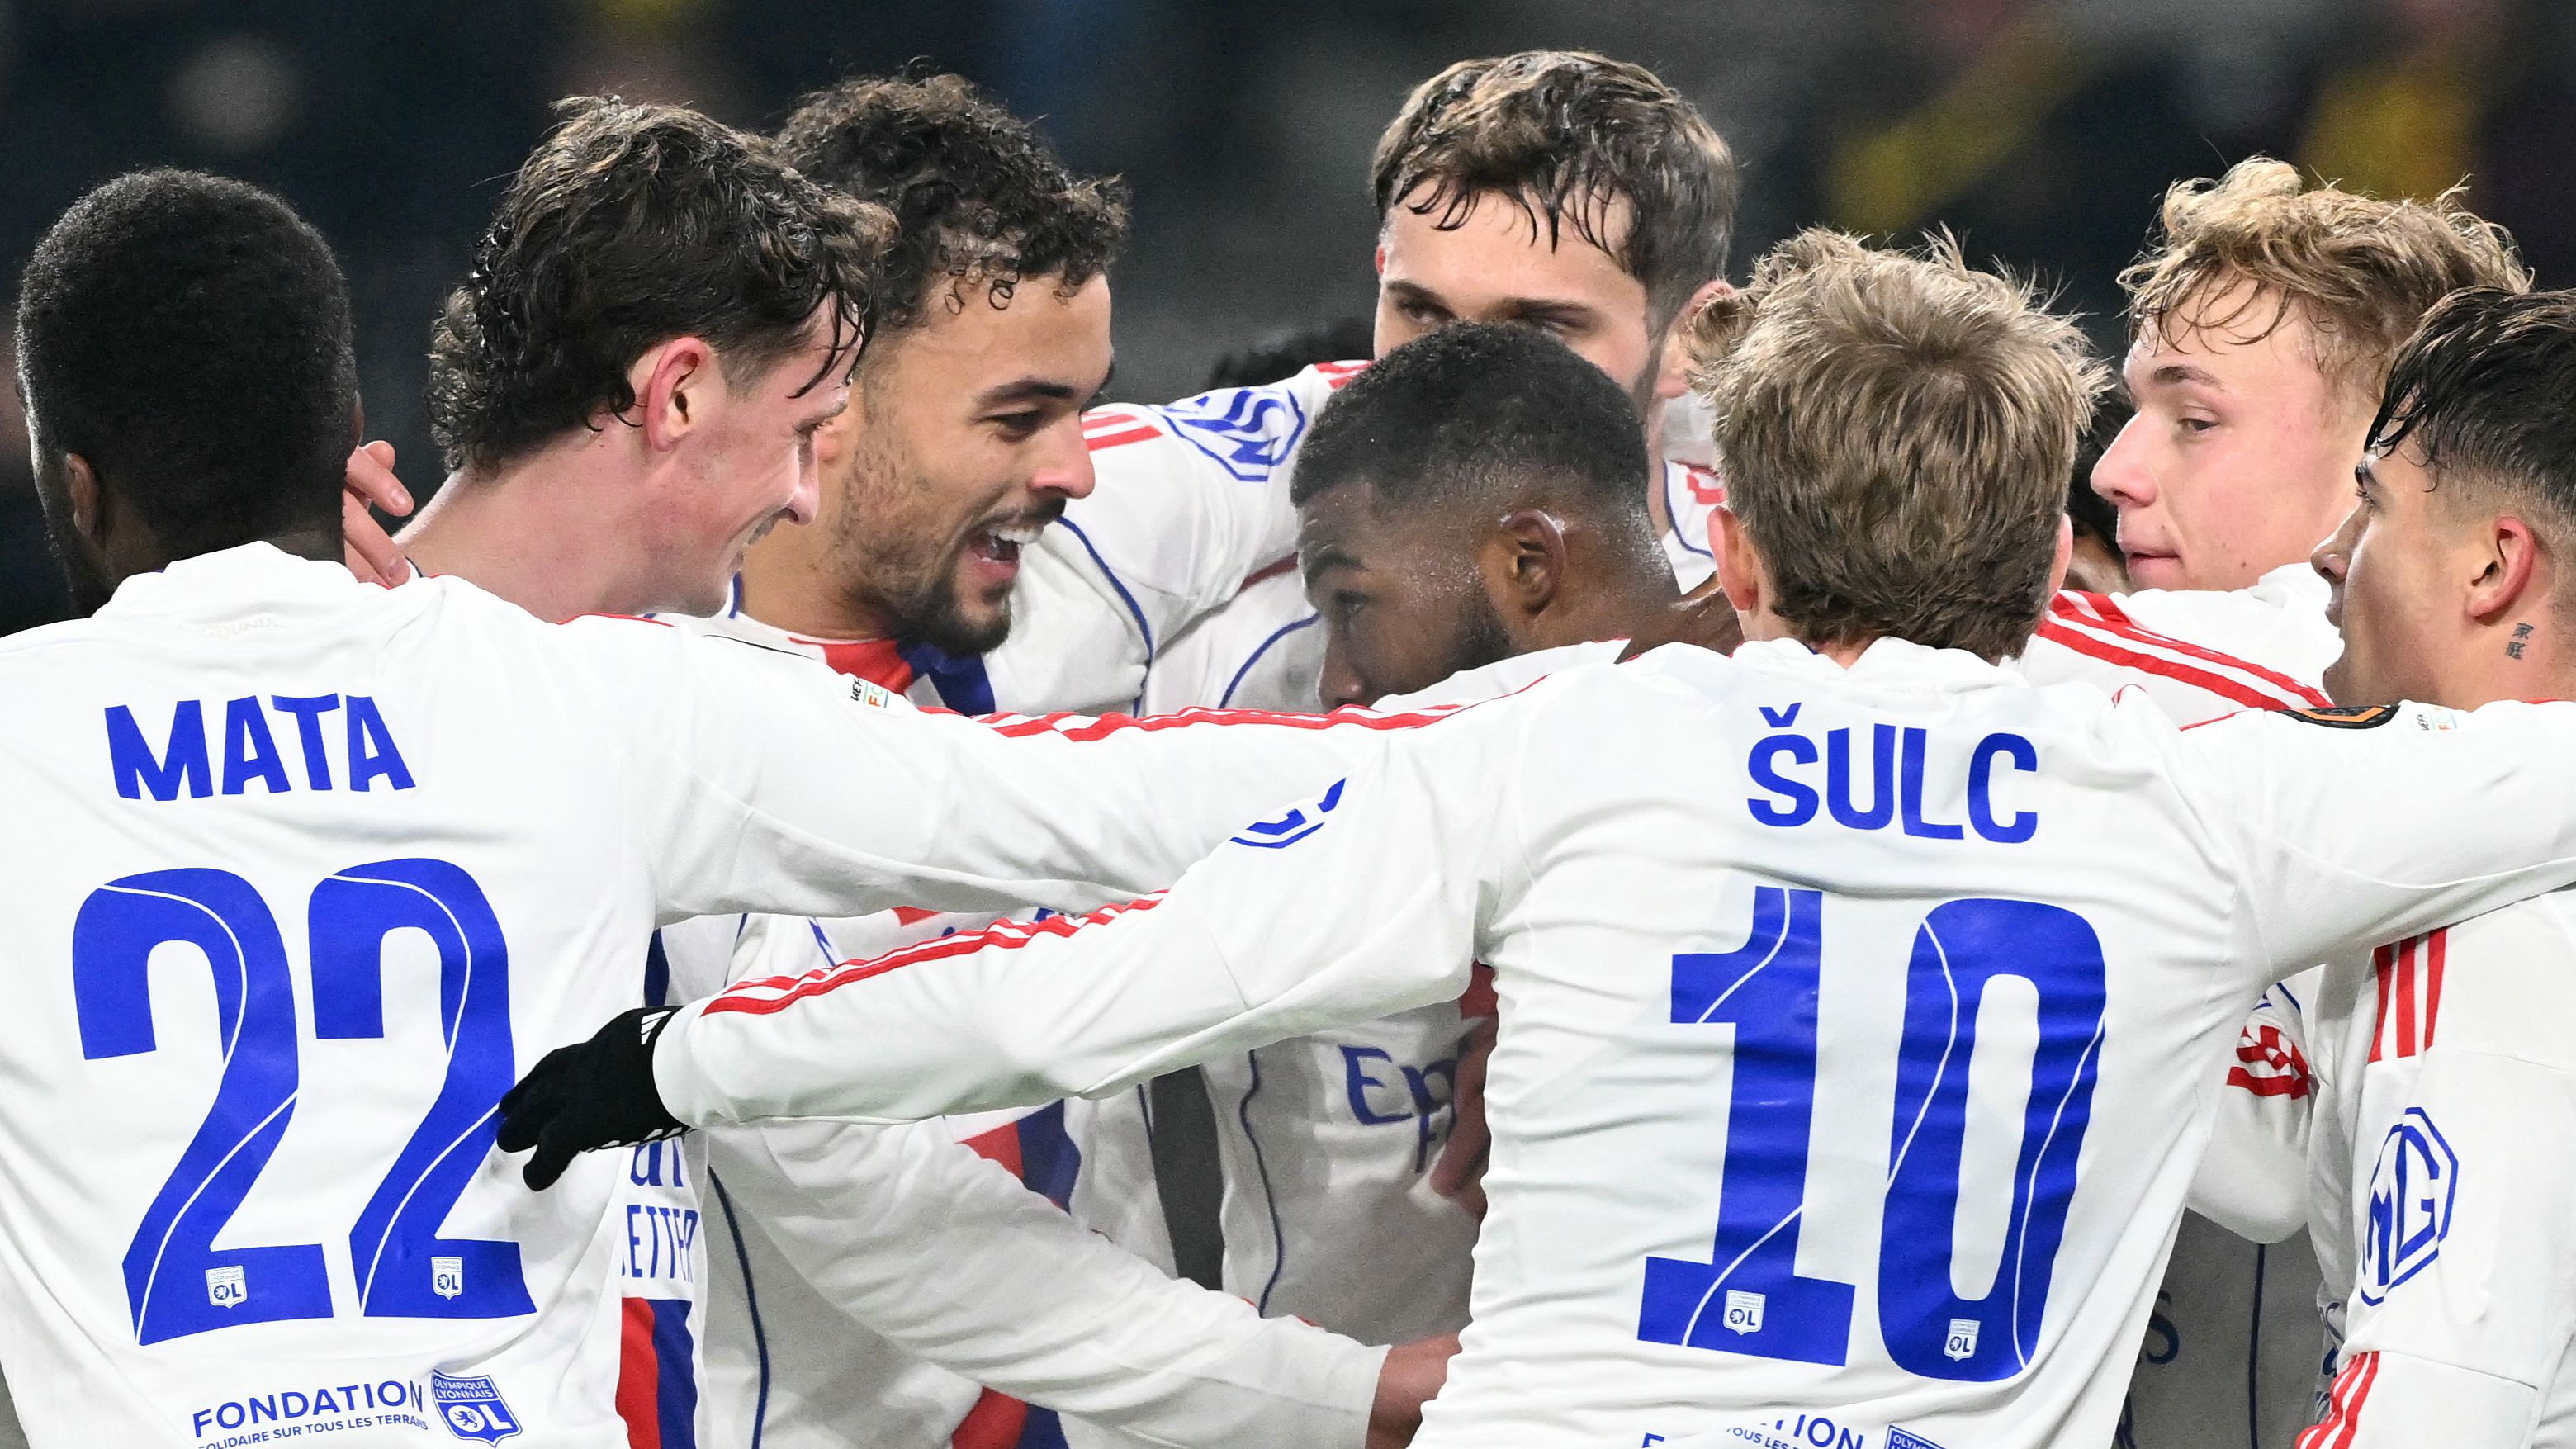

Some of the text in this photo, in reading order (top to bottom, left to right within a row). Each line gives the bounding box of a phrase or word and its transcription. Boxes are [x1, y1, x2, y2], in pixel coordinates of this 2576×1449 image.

[104, 693, 417, 802] MATA
[1746, 702, 2039, 844] ŠULC
[72, 857, 538, 1347] 22
[1636, 885, 2107, 1383] 10
[622, 1205, 700, 1283] ETTER
[192, 1380, 424, 1438] FONDATION
[434, 1377, 490, 1390] OLYMPIQUE
[435, 1389, 495, 1399] LYONNAIS
[272, 1426, 302, 1440] SUR
[305, 1420, 344, 1434] TOUS
[348, 1417, 373, 1429] LES
[1726, 1428, 1763, 1443] OUS
